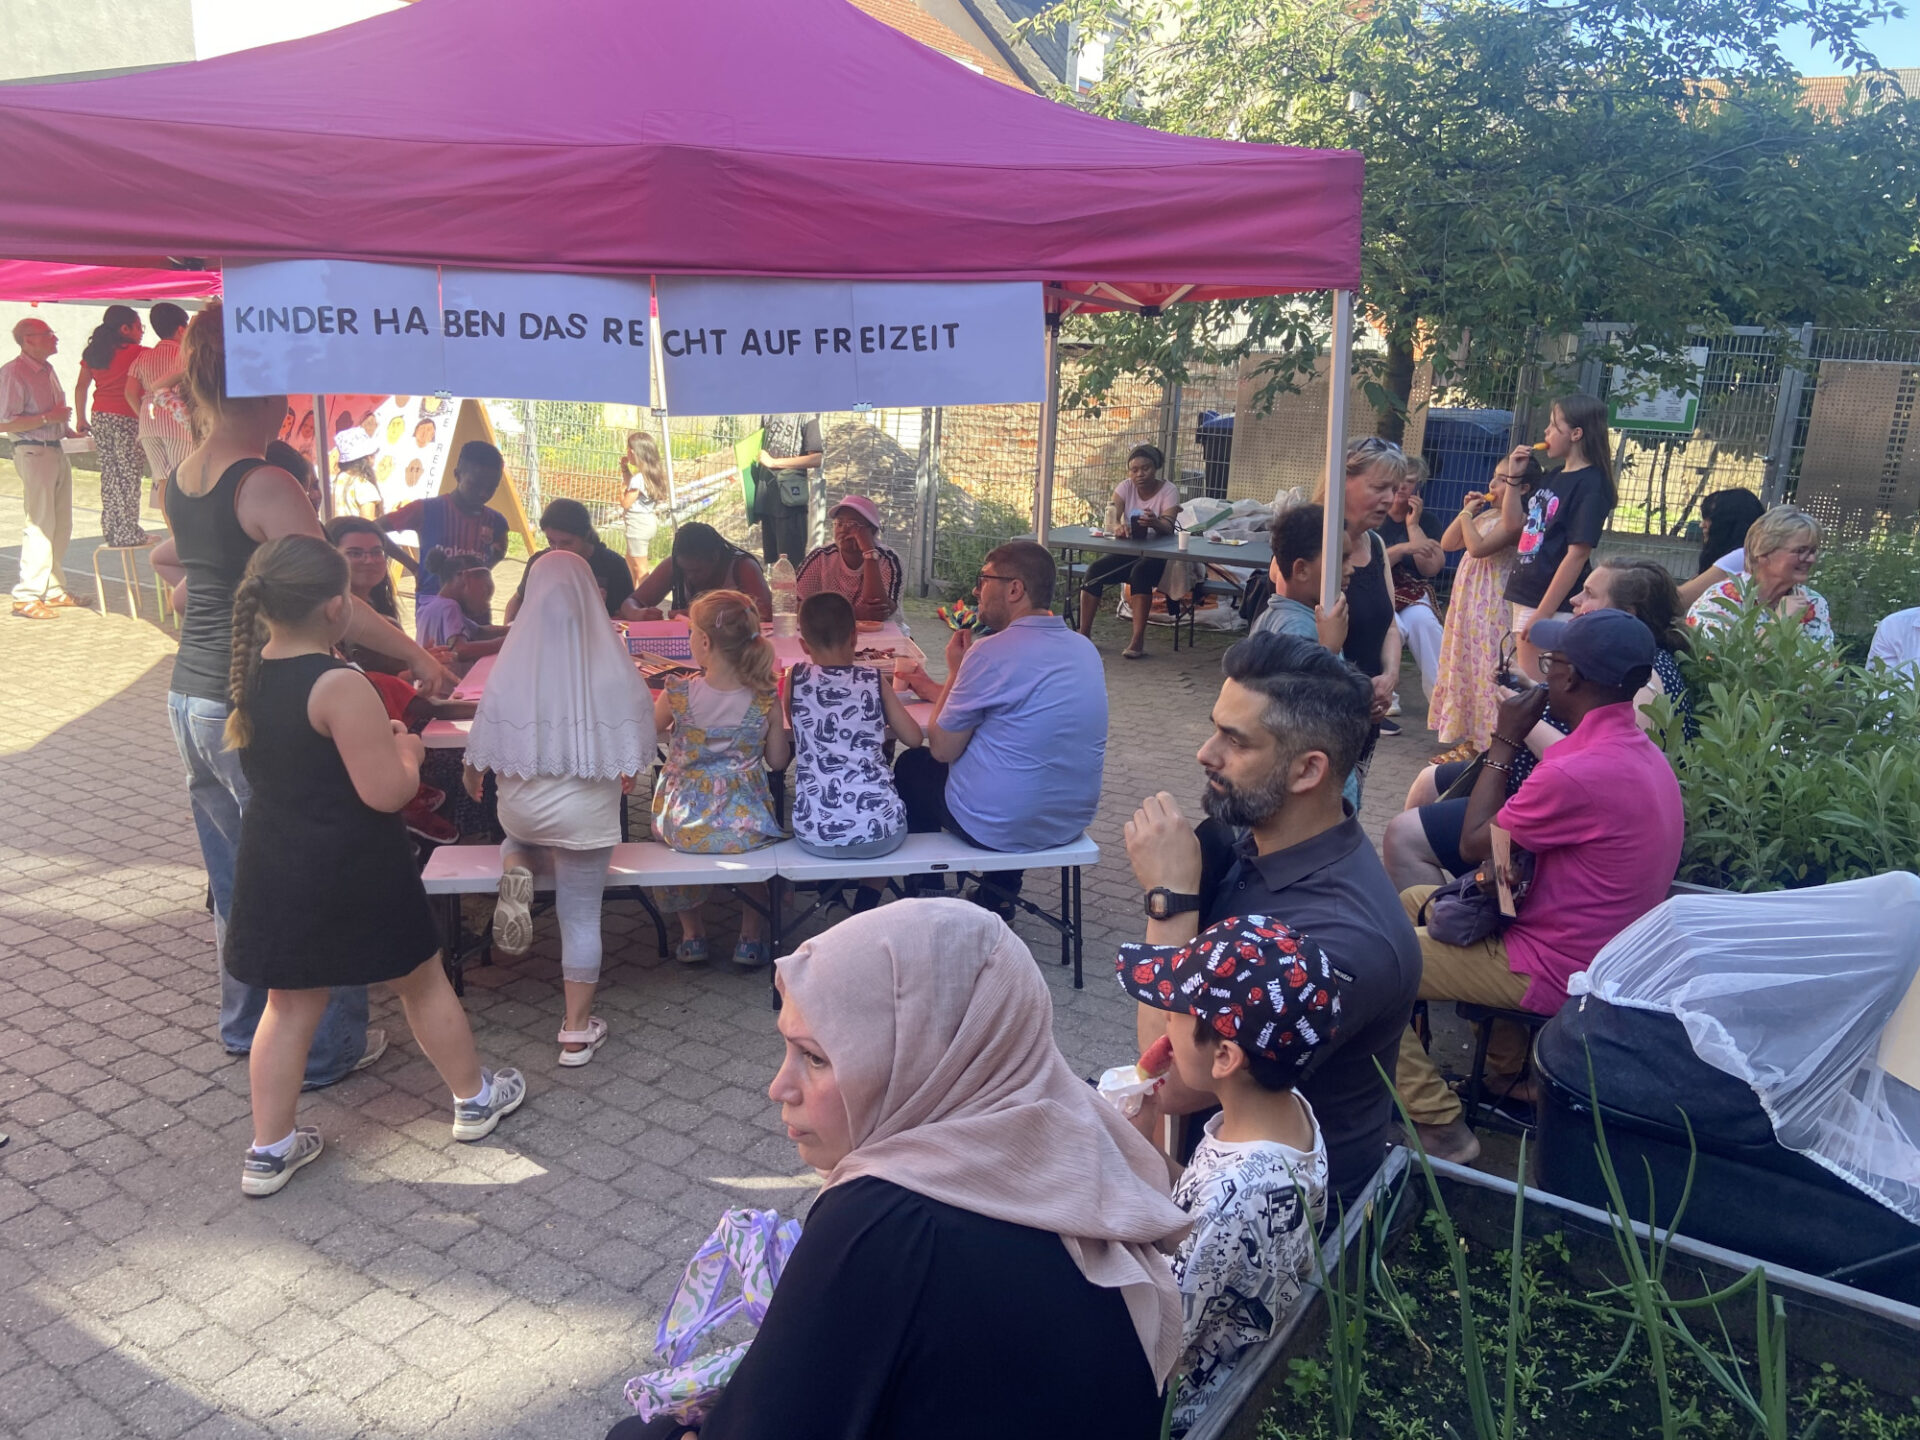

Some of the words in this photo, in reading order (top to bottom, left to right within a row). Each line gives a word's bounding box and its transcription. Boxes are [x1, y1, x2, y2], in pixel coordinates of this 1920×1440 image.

[235, 305, 359, 336] KINDER
[519, 312, 588, 341] DAS
[740, 328, 802, 357] AUF
[814, 321, 960, 355] FREIZEIT
[1206, 940, 1230, 972] MARVEL
[1266, 977, 1285, 1013] MARVEL
